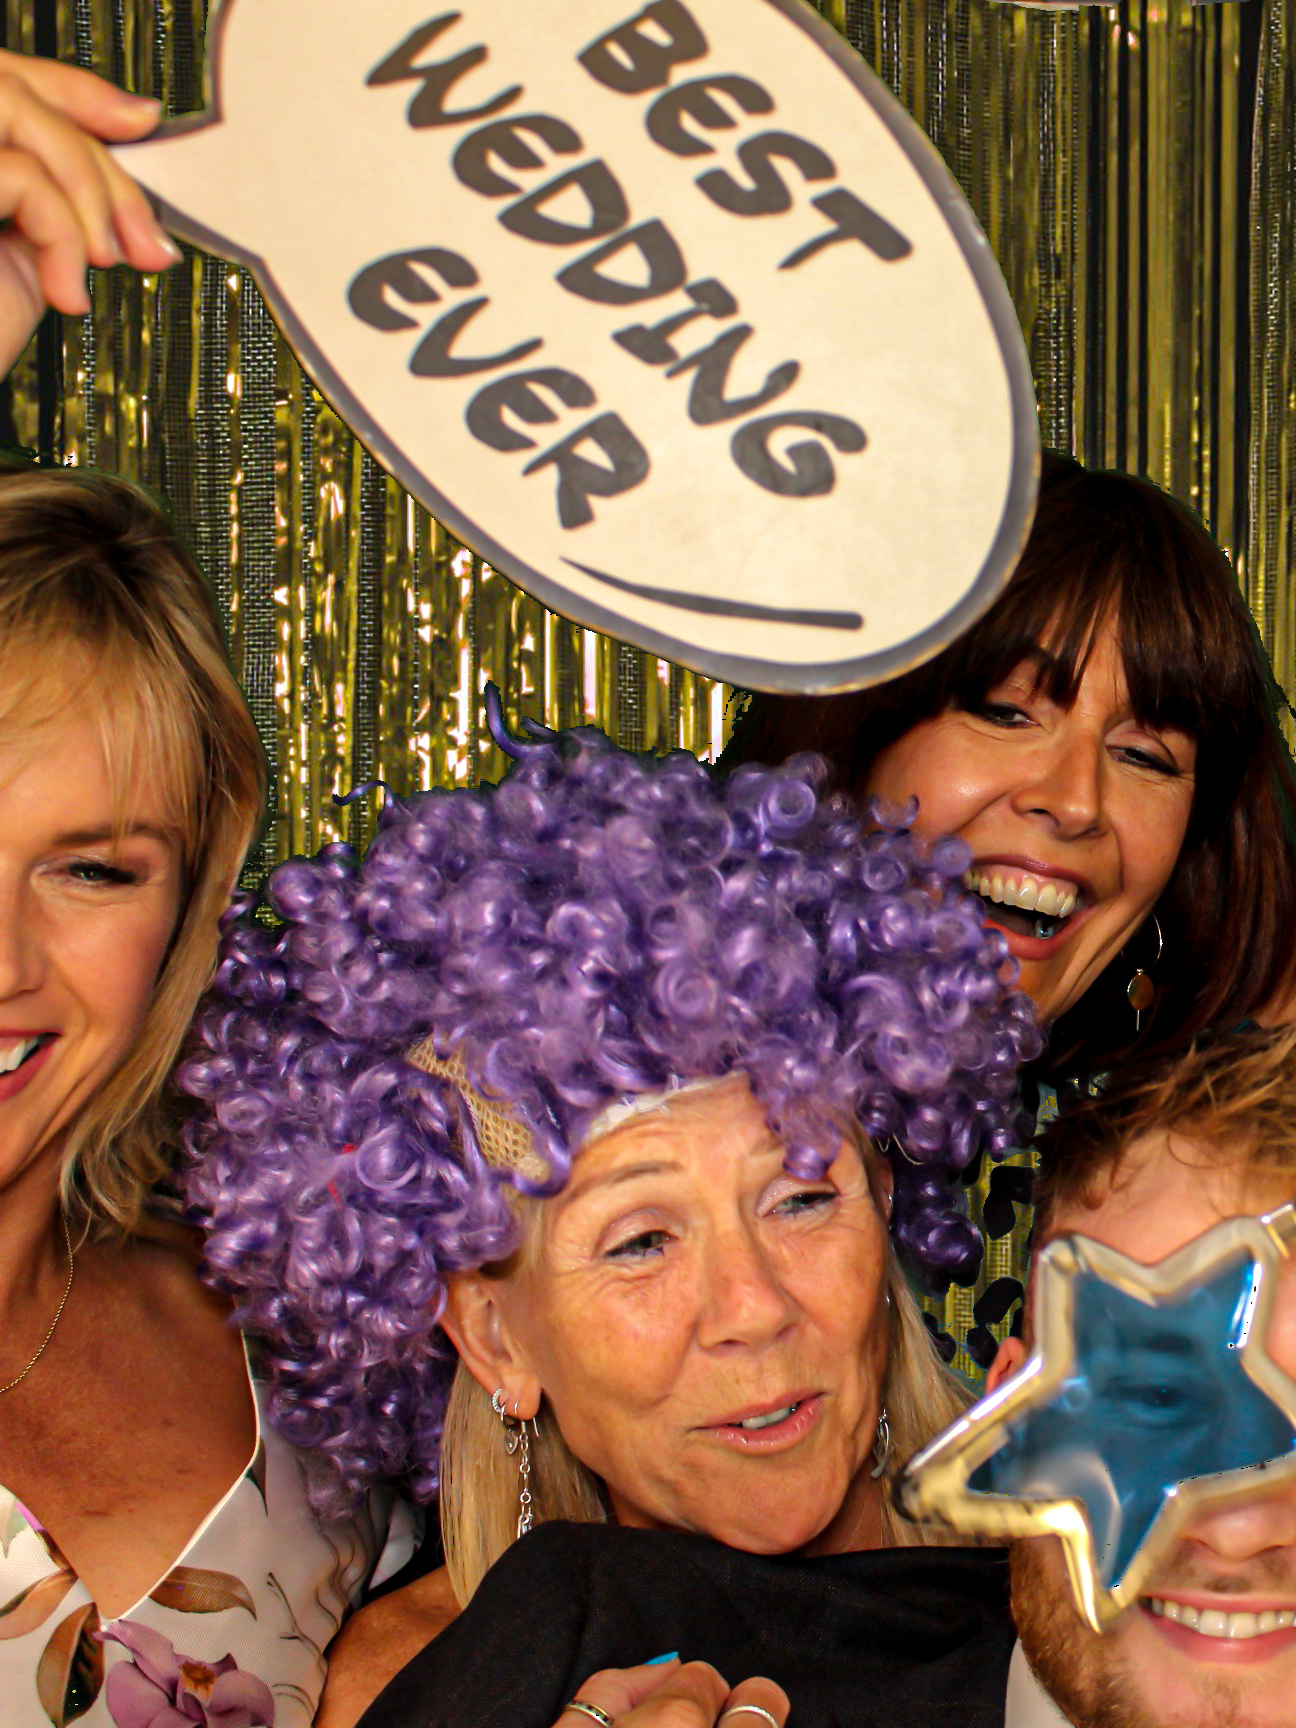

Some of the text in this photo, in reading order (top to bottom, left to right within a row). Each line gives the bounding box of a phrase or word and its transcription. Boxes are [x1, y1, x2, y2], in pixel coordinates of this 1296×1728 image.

[366, 11, 867, 498] WEDDING
[577, 0, 912, 269] BEST
[347, 247, 650, 530] EVER
